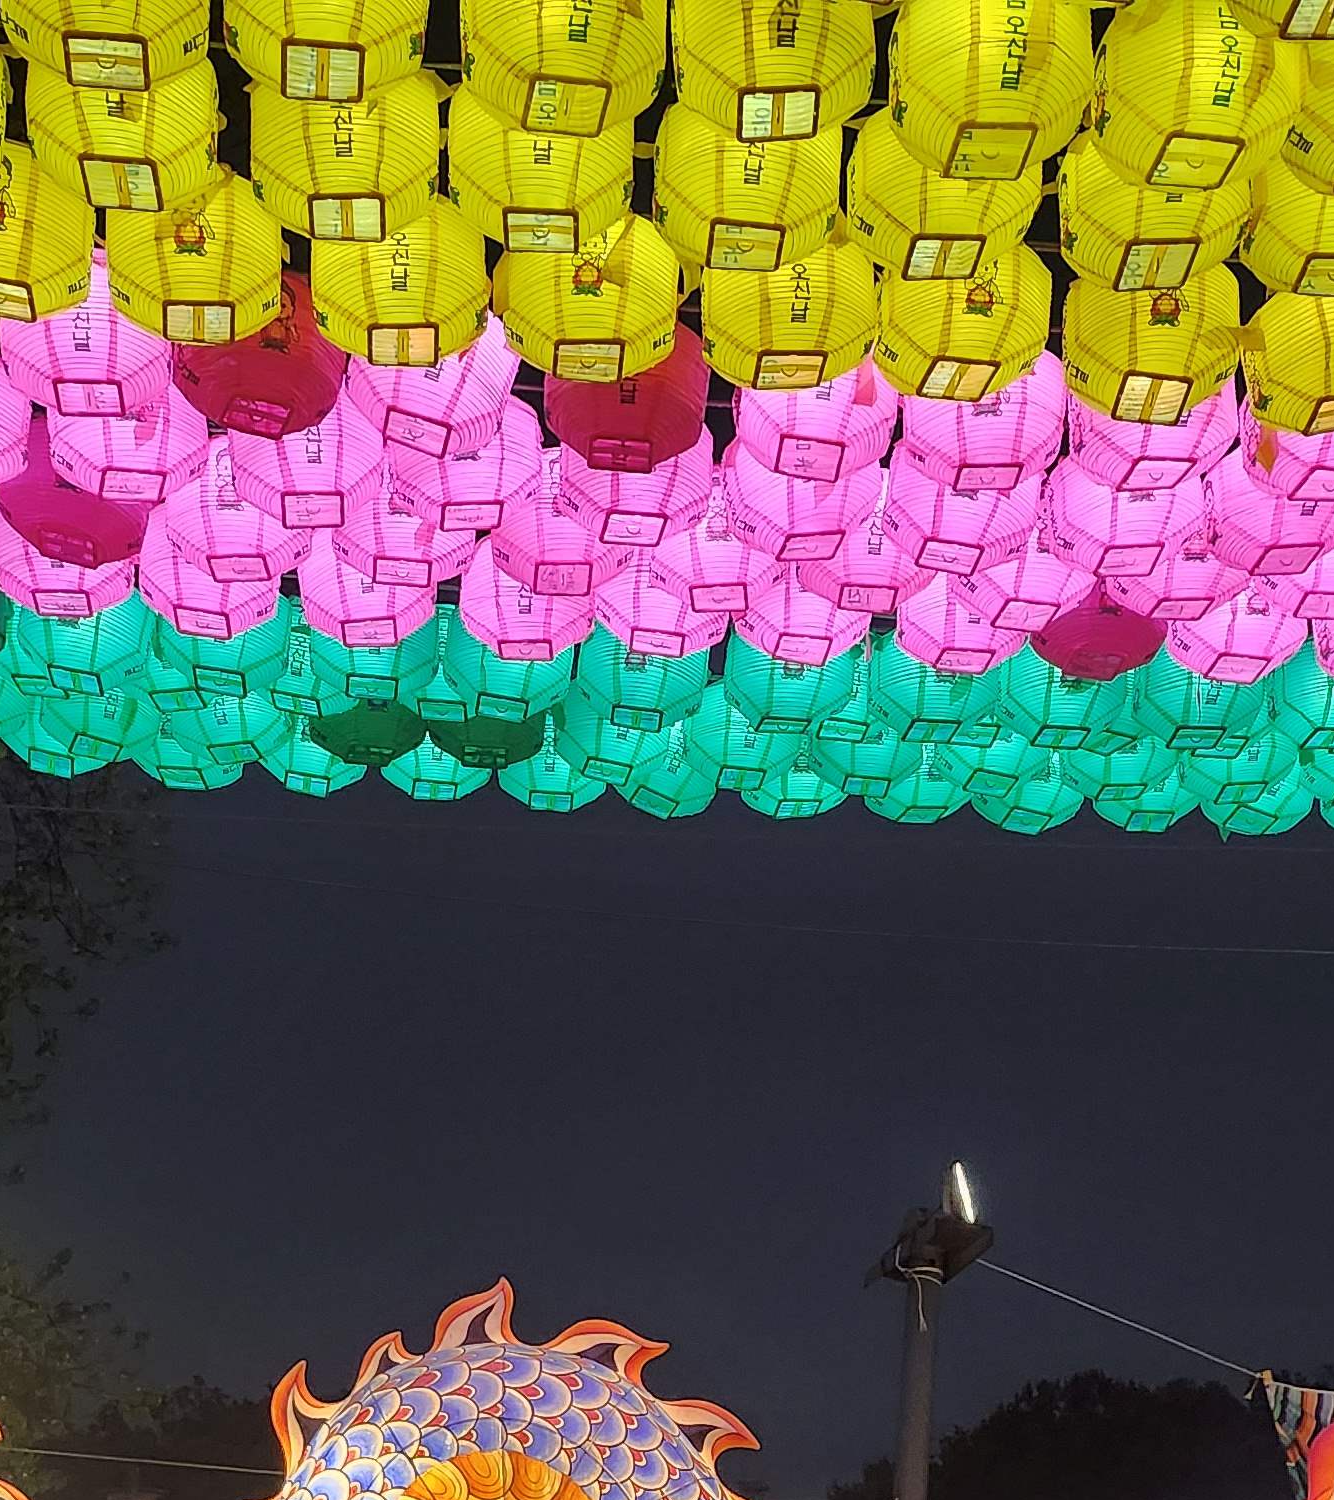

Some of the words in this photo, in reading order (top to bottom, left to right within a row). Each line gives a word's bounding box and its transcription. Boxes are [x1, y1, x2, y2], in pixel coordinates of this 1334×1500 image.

[776, 0, 801, 48] 신날
[743, 142, 765, 185] 신날
[303, 425, 322, 463] 신날
[517, 587, 533, 613] 신날
